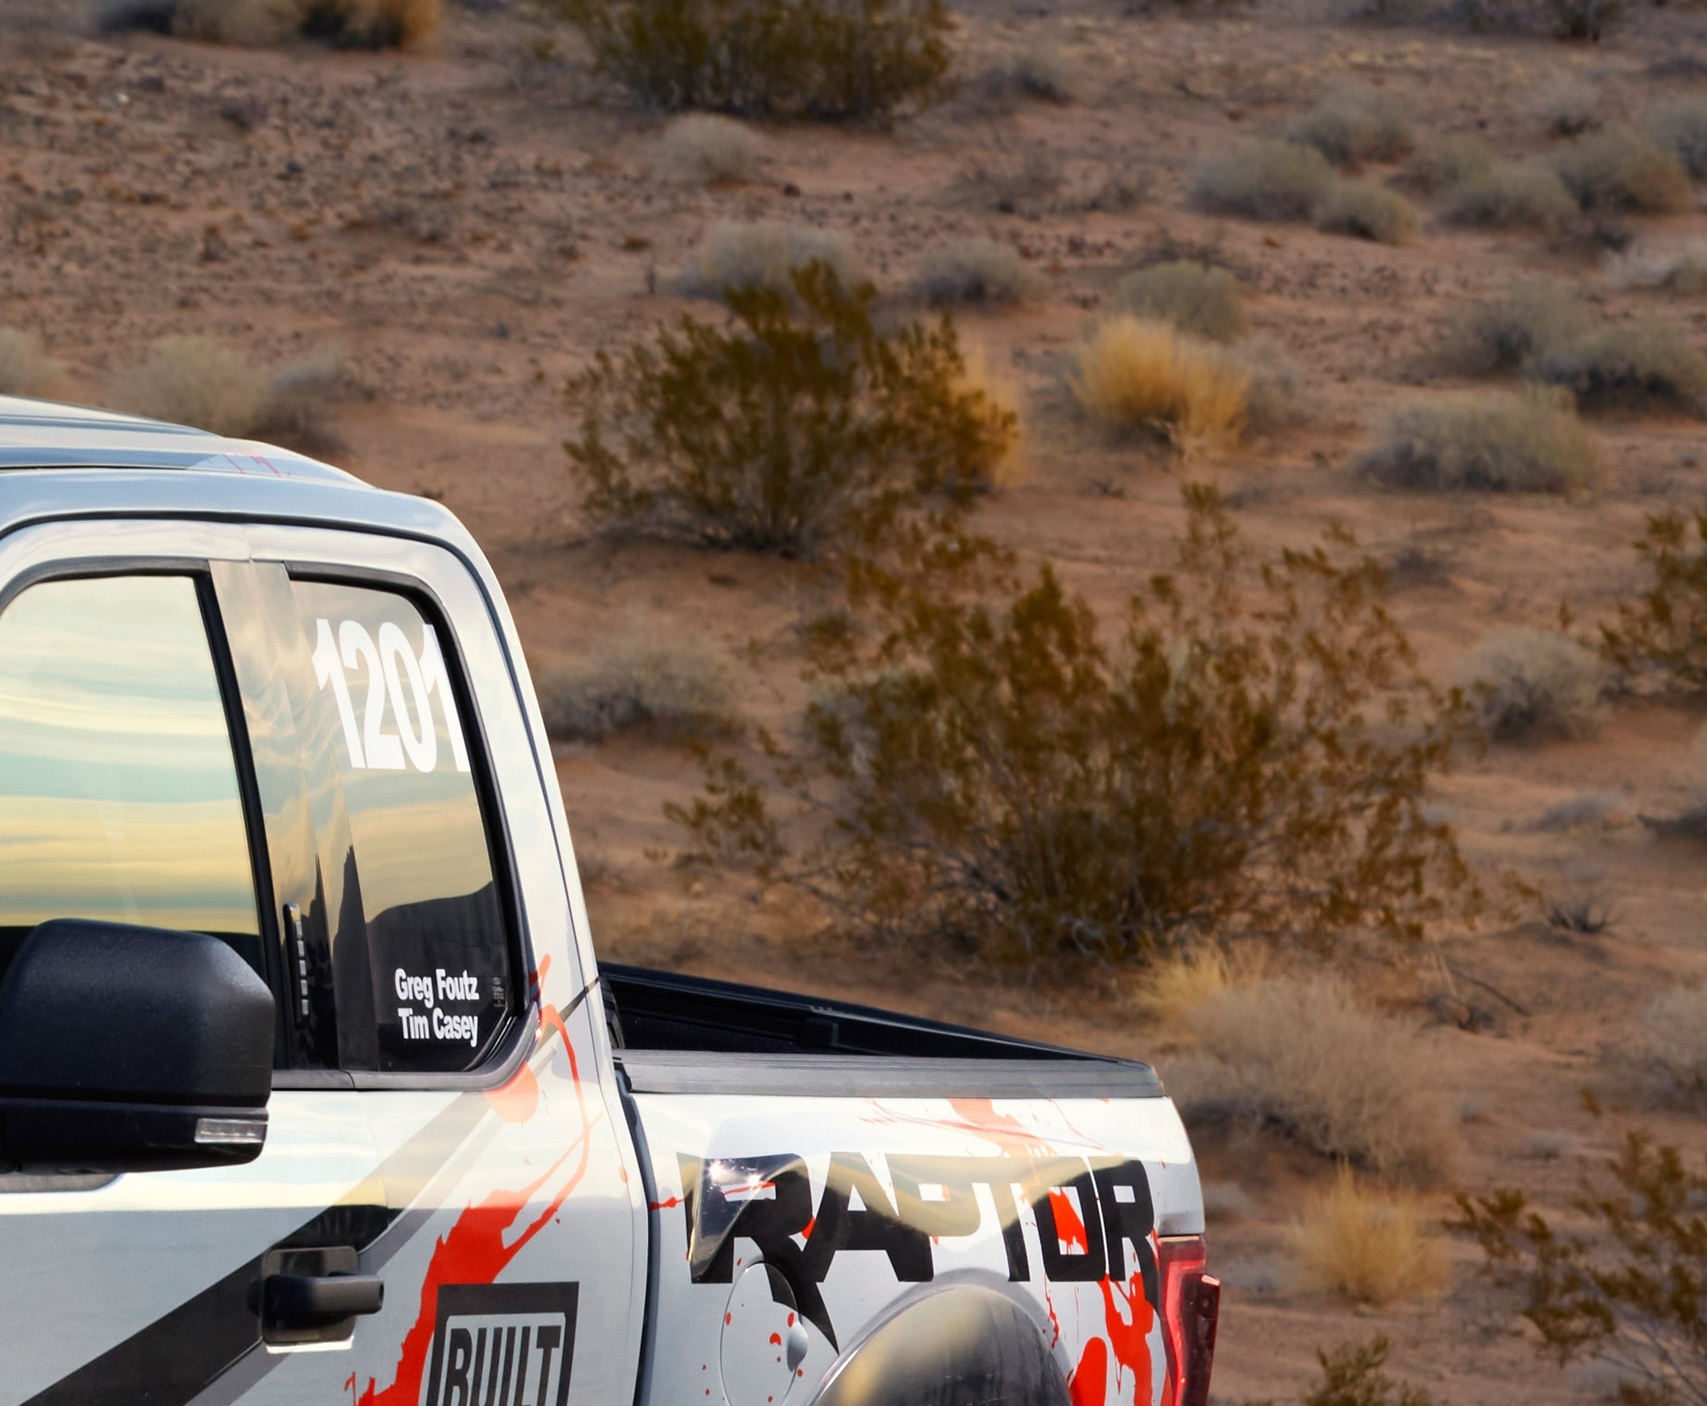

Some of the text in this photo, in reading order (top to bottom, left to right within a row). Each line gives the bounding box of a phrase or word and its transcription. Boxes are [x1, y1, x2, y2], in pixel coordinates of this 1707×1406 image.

[312, 618, 472, 774] 1201
[394, 967, 434, 1009] Greg
[435, 968, 480, 1001] Foutz
[397, 1007, 479, 1048] Tim Casey
[677, 1150, 1160, 1354] RAPTOR
